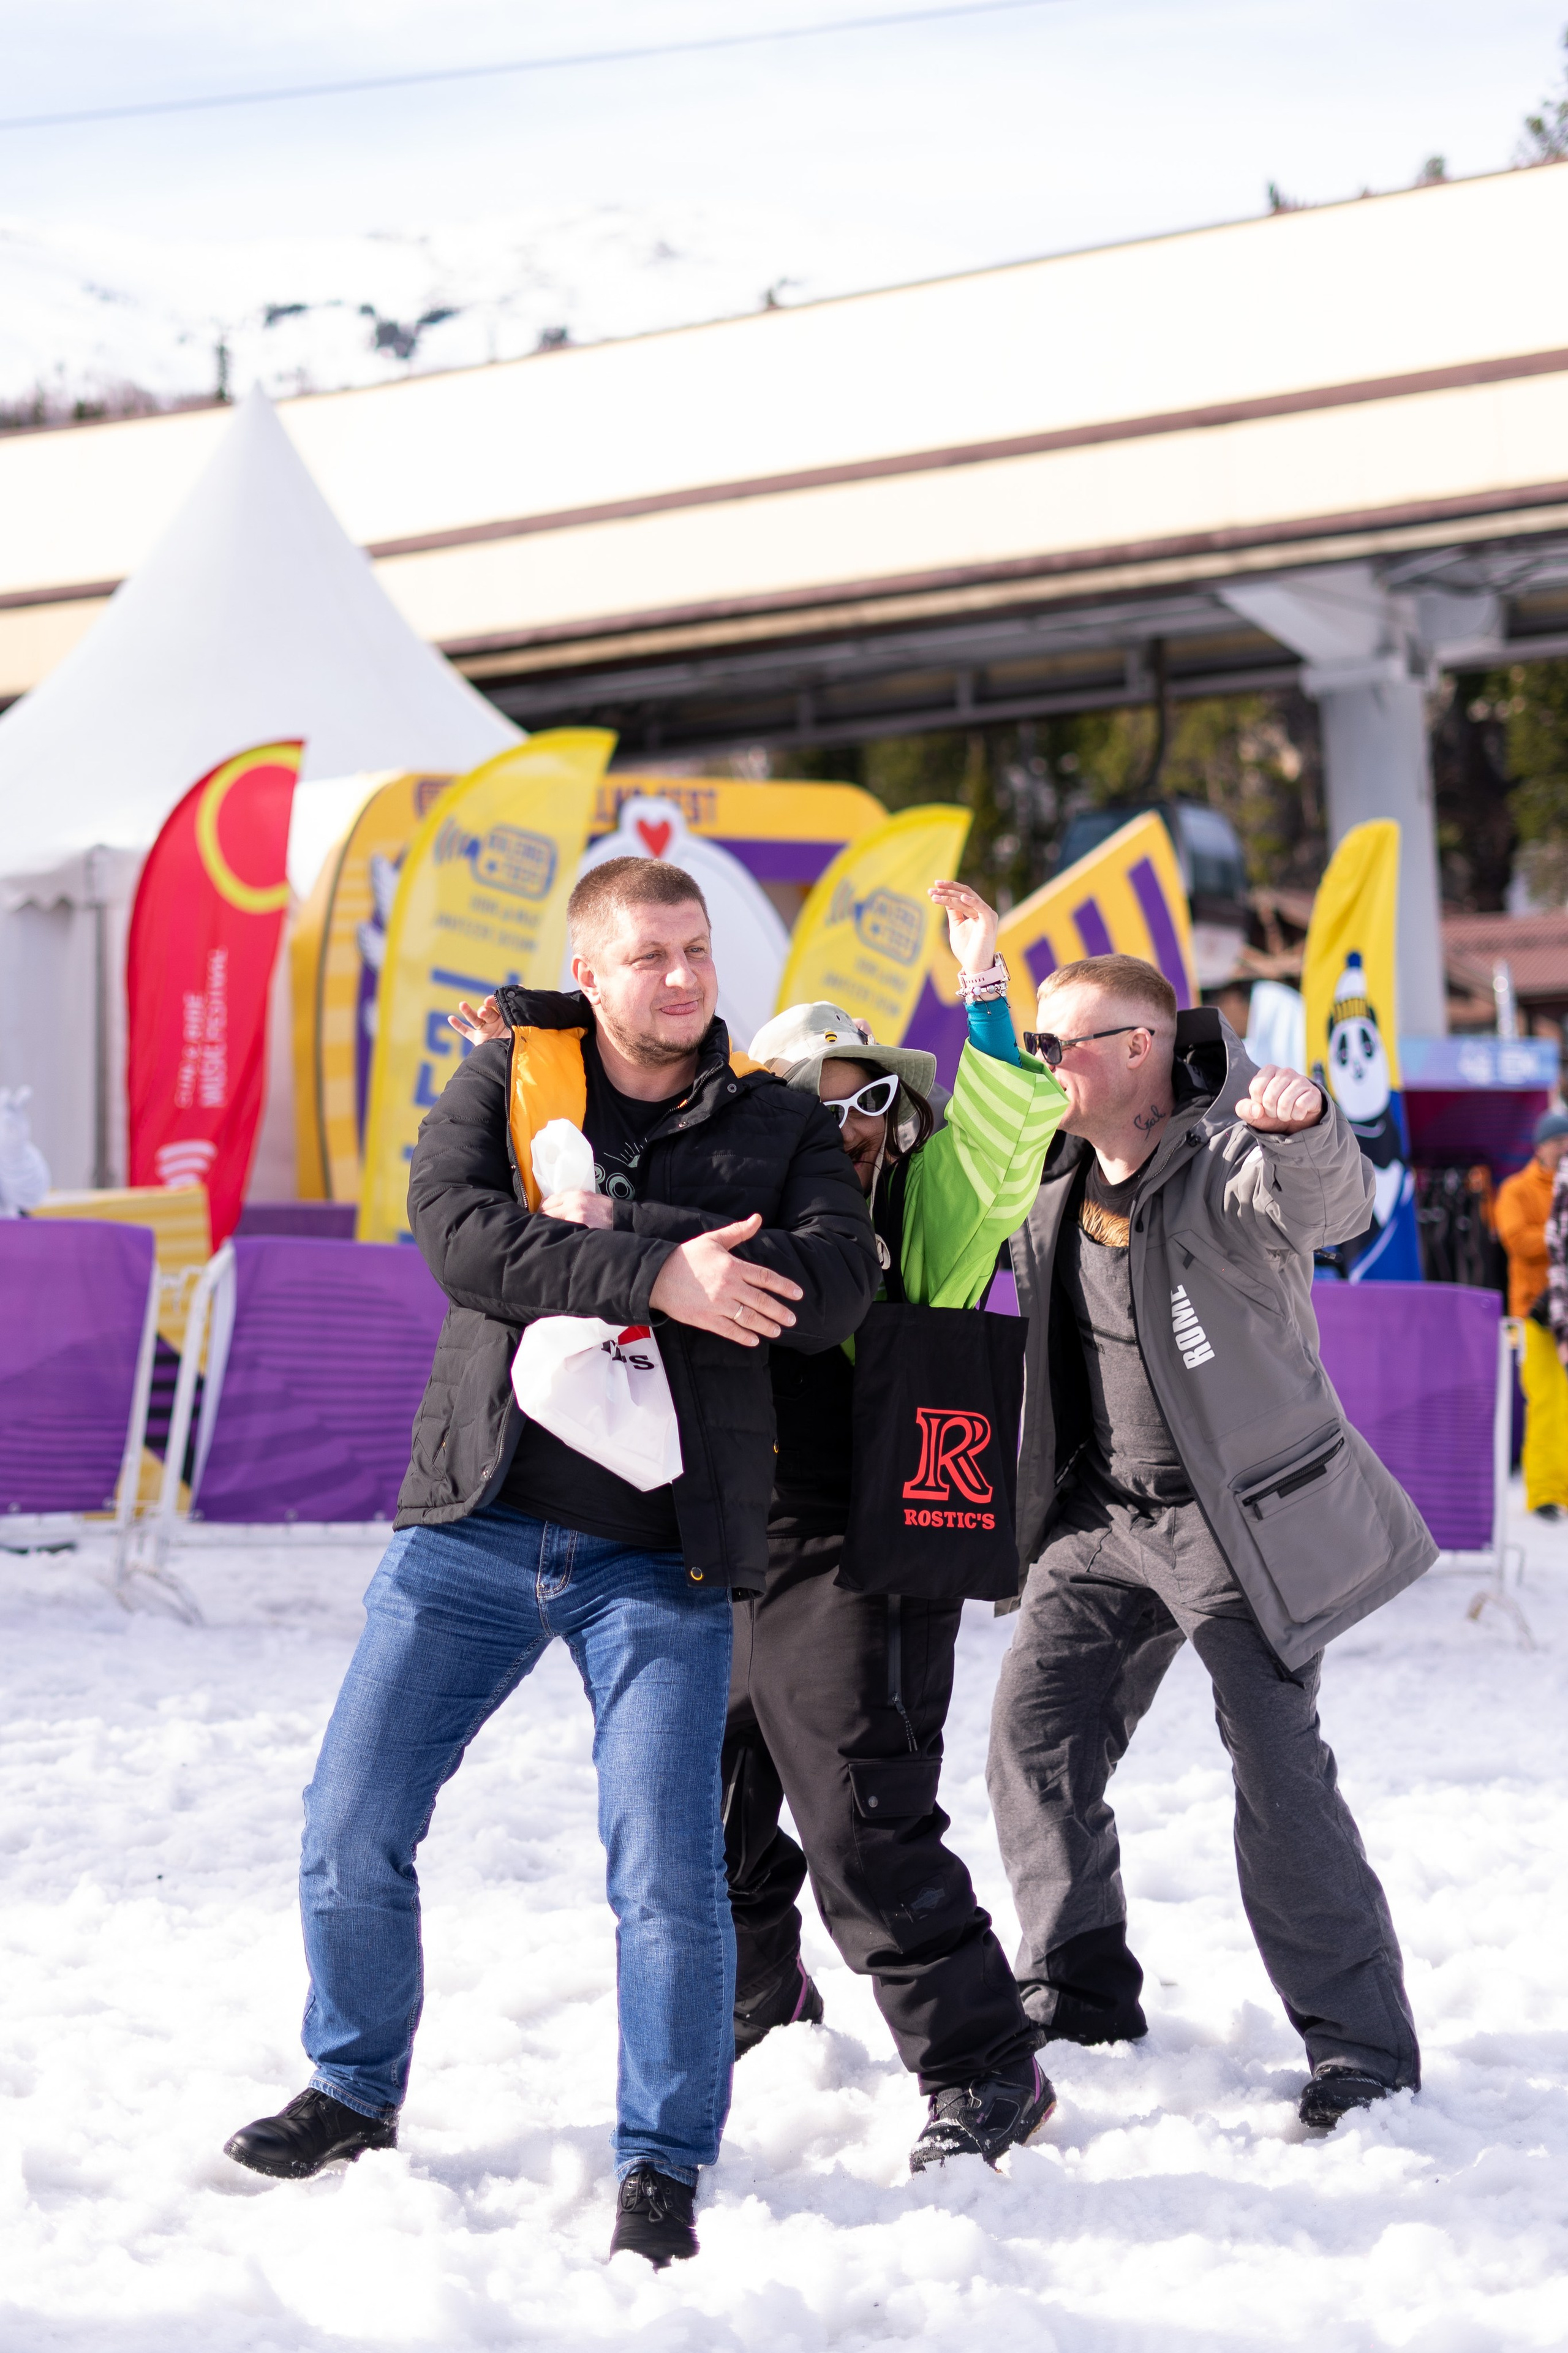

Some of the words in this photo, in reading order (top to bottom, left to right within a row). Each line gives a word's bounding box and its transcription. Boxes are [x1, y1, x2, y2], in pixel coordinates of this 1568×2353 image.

[1170, 1285, 1215, 1369] ROME
[902, 1407, 993, 1503] R
[903, 1509, 995, 1530] ROSTIC'S
